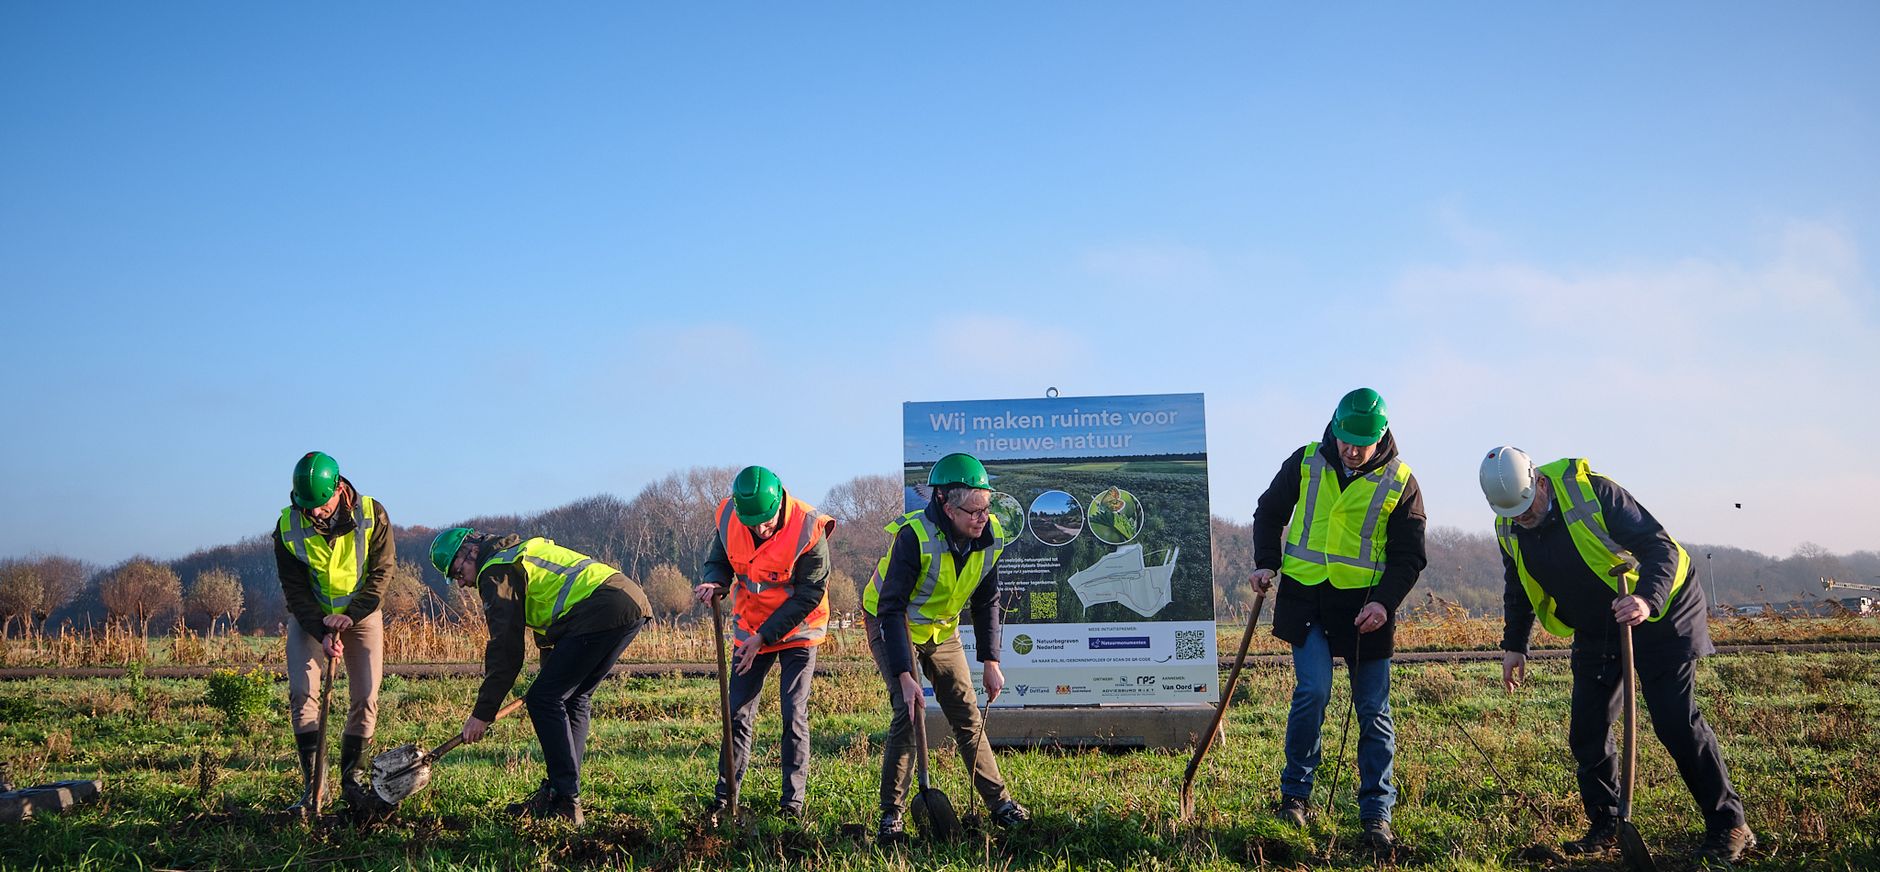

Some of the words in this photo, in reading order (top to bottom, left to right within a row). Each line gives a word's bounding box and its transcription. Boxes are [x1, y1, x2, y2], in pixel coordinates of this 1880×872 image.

[929, 412, 966, 435] Wij
[972, 411, 1044, 430] maken
[1051, 408, 1122, 428] ruimte
[1128, 409, 1178, 426] voor
[975, 433, 1054, 451] nieuwe
[1060, 432, 1132, 449] natuur
